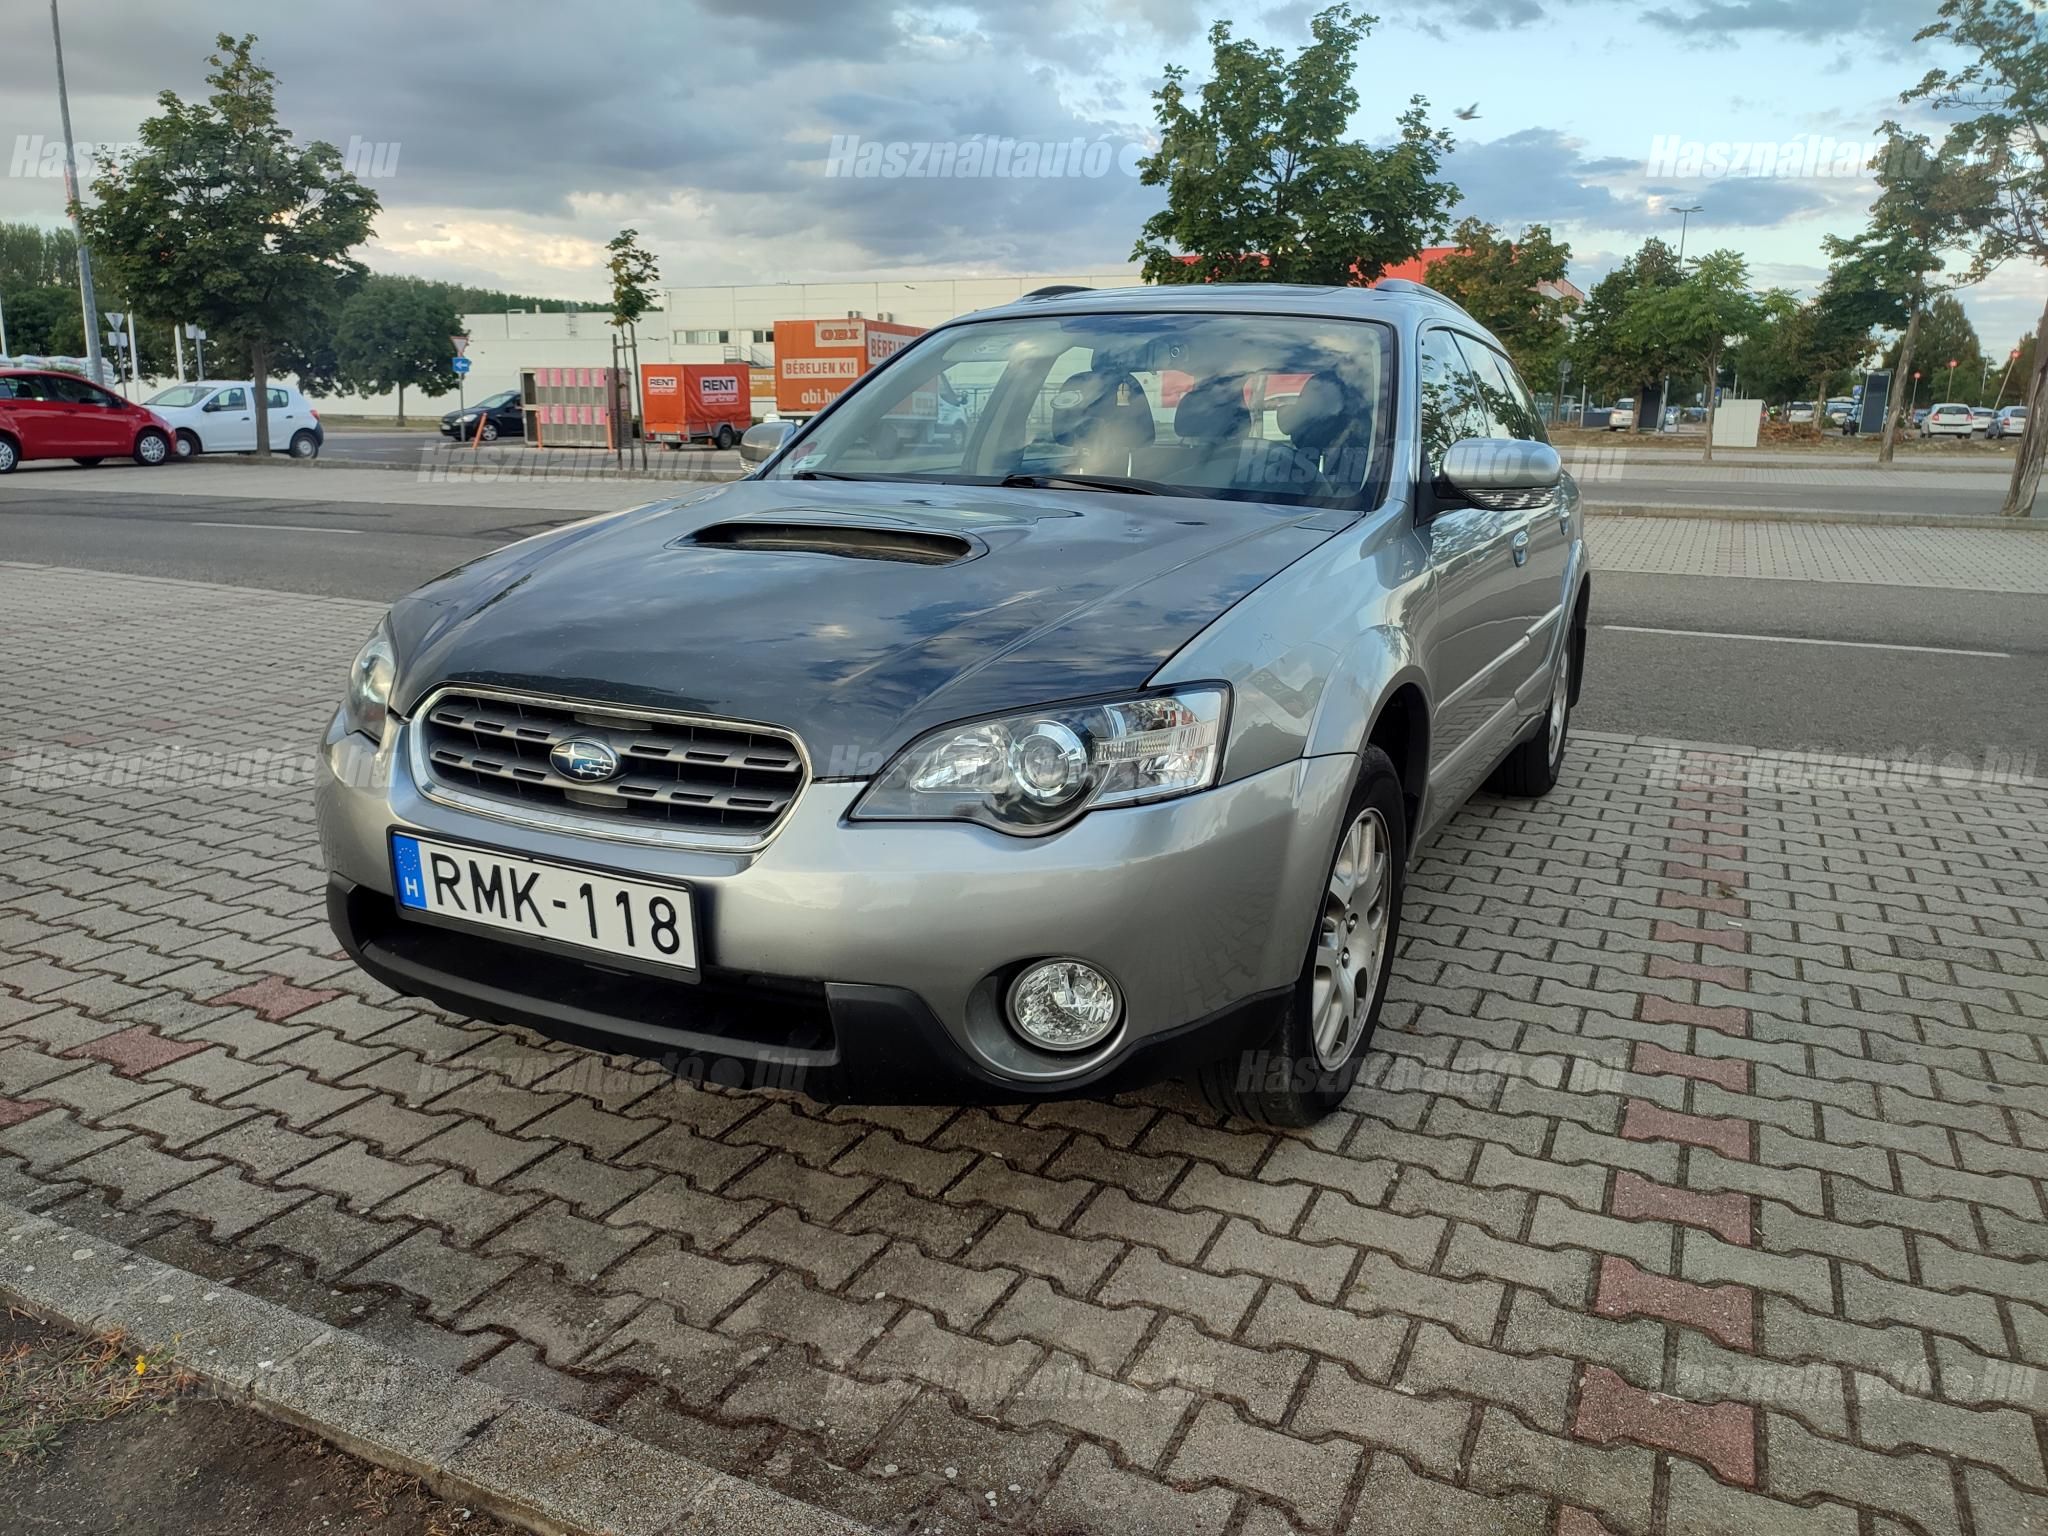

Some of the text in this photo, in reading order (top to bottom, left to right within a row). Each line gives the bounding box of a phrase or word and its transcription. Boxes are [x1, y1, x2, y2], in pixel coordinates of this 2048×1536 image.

[820, 328, 859, 340] OBI
[785, 360, 855, 374] BÉRELJEN KI!
[649, 378, 675, 386] RENT
[702, 379, 736, 391] RENT
[404, 877, 419, 899] H
[430, 852, 680, 955] RMK-118
